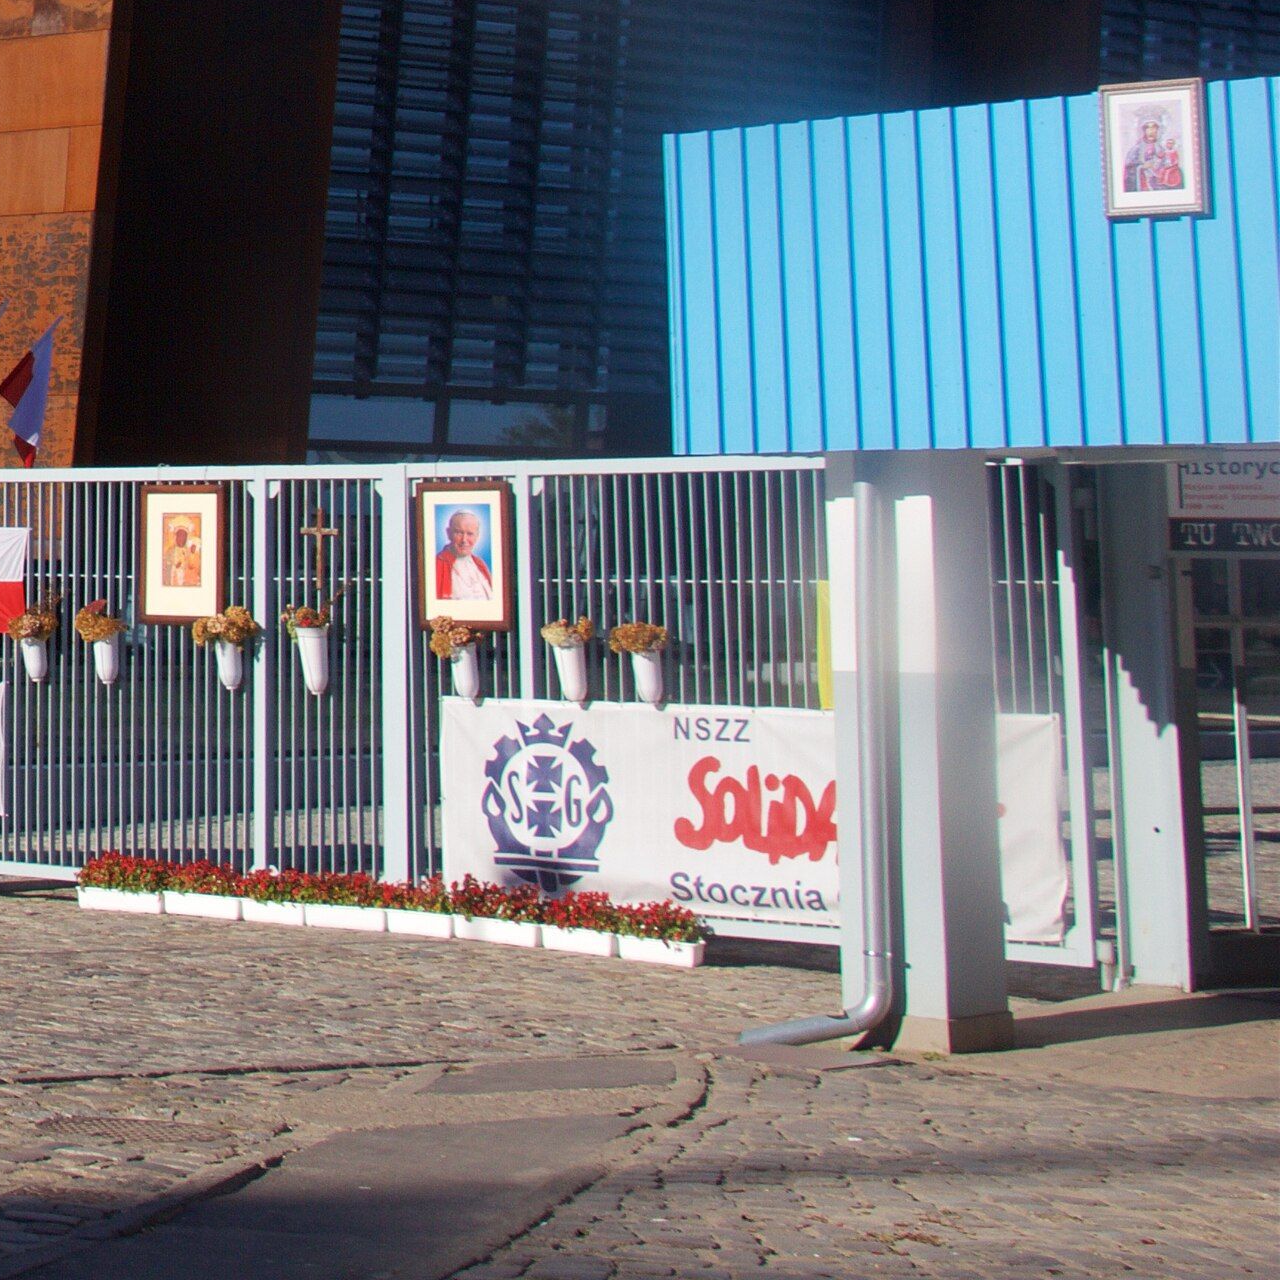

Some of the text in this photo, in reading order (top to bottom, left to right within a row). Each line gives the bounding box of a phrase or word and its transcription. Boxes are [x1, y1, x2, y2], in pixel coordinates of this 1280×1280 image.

[1181, 522, 1217, 546] TU
[673, 716, 751, 742] NSZZ
[670, 871, 828, 911] Stocznia
